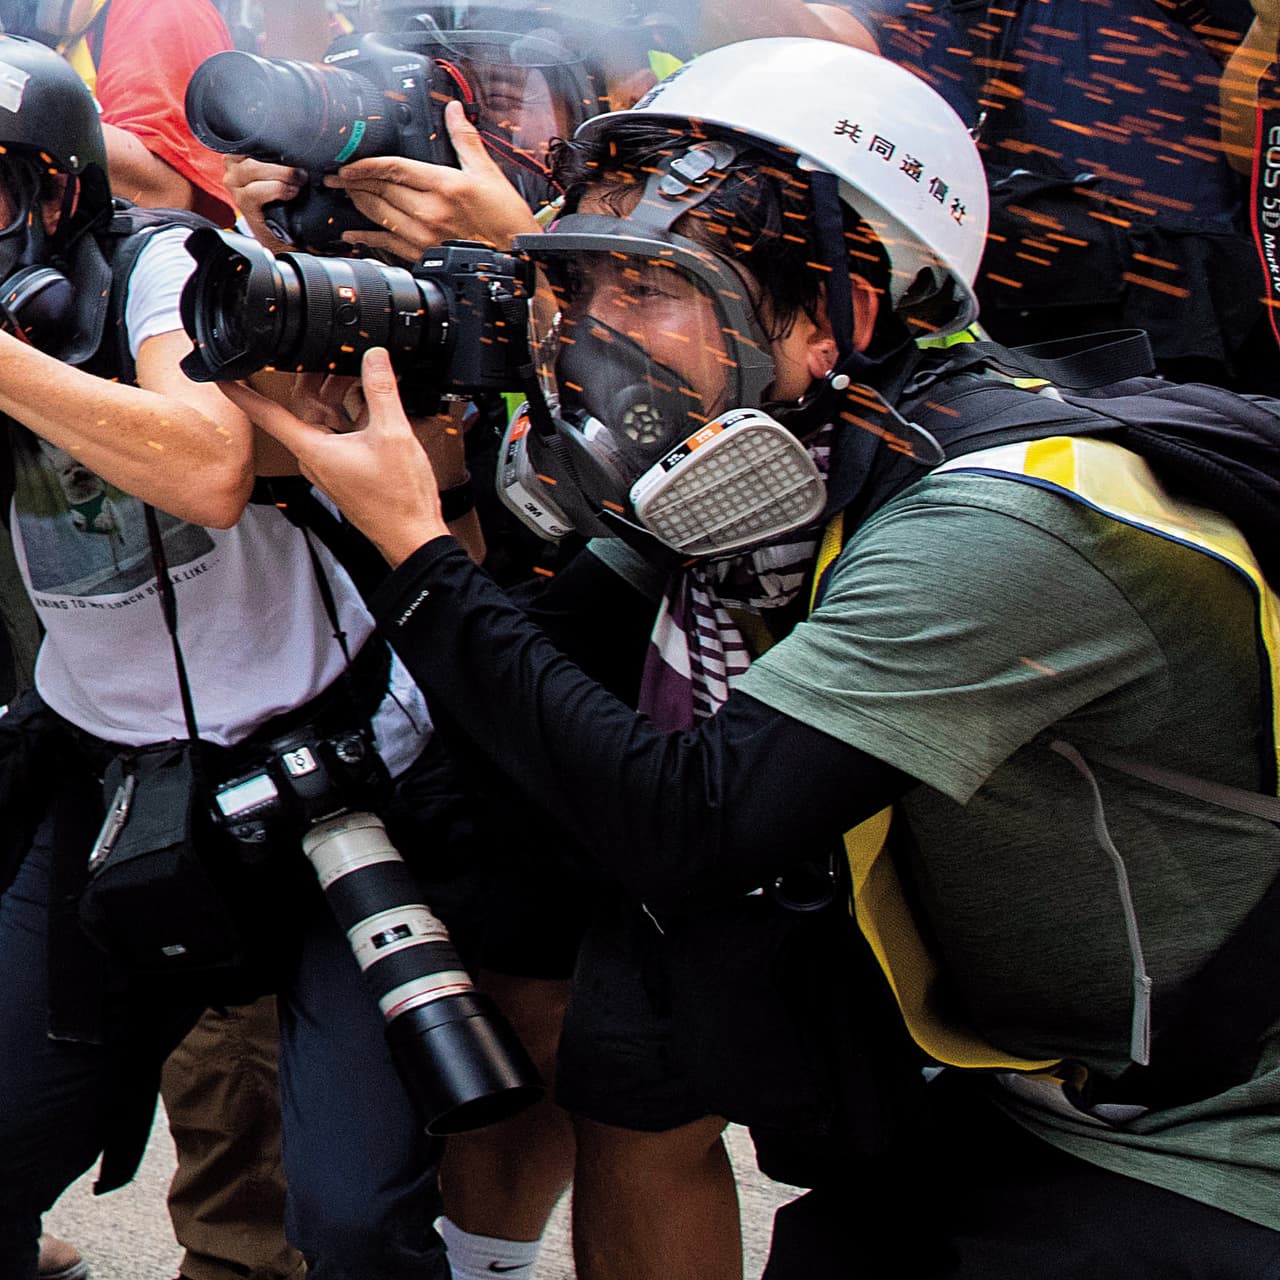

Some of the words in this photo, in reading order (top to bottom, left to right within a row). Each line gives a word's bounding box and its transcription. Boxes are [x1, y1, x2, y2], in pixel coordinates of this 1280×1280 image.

[833, 119, 965, 227] 共同通信社
[524, 502, 543, 518] 3M
[69, 598, 87, 610] TO
[107, 591, 146, 611] LUNCH
